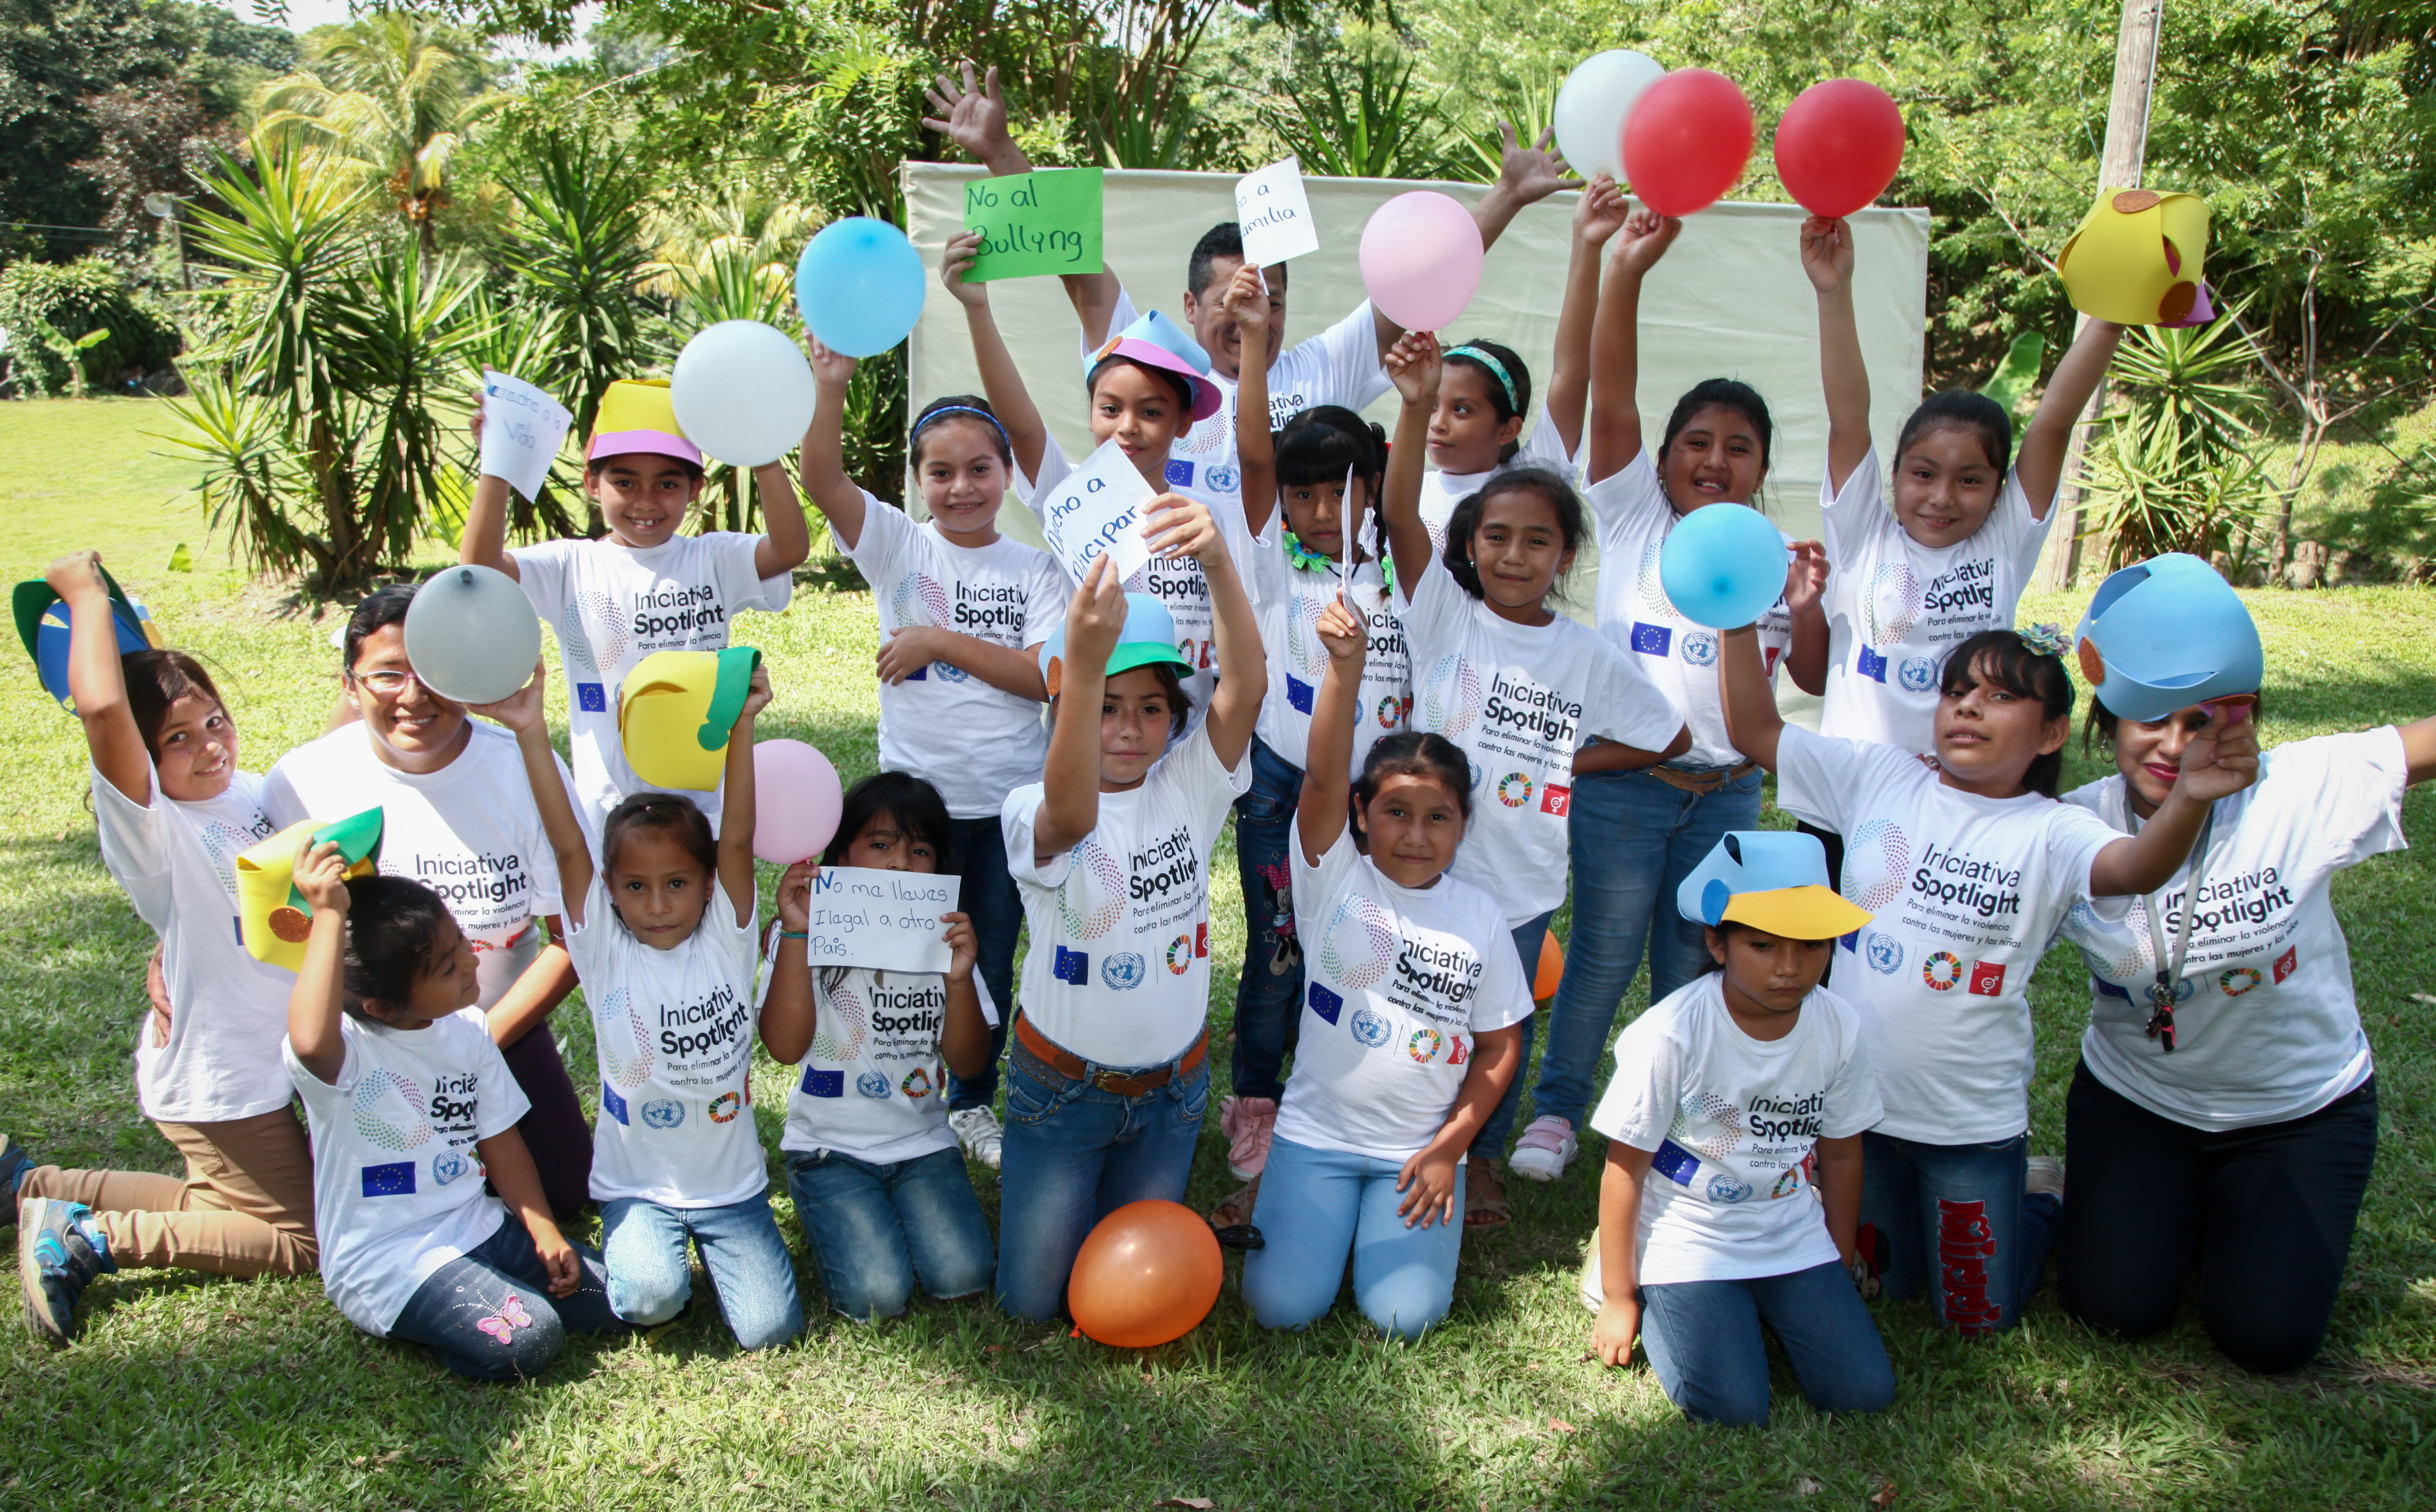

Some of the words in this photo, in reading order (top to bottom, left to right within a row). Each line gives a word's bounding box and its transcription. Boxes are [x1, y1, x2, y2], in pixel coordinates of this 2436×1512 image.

[968, 186, 998, 214] No
[1011, 179, 1038, 207] al
[1243, 207, 1297, 237] amilia
[973, 223, 1083, 262] Bullyng
[1233, 392, 1304, 412] Iativa
[1087, 477, 1106, 493] a
[635, 585, 714, 611] Iniciativa
[957, 580, 1028, 605] Iniciativ
[1925, 579, 1993, 613] Spotlig
[634, 604, 725, 638] Spotlight
[955, 603, 1026, 632] Spotlig
[1928, 617, 1946, 626] Para
[1948, 613, 1976, 624] eliminar
[638, 642, 656, 650] Para
[659, 638, 687, 648] eliminar
[689, 636, 697, 644] la
[976, 630, 1004, 639] eliminar
[1929, 632, 1951, 641] contra
[1953, 630, 1964, 638] las
[1375, 673, 1384, 682] las
[1491, 672, 1582, 719] Iniciativa
[1485, 697, 1578, 742] Spotligh
[1481, 725, 1499, 737] Para
[1501, 731, 1533, 745] eliminar
[1534, 740, 1541, 748] la
[1541, 742, 1573, 758] violencia
[1478, 741, 1502, 753] contra
[1504, 746, 1516, 756] las
[1517, 752, 1542, 764] mujeres
[1550, 759, 1560, 770] las
[416, 852, 519, 875] Iniciativa
[1922, 843, 2020, 887] Iniciativa
[816, 871, 842, 894] No
[1912, 868, 2020, 917] Spotlight
[2166, 867, 2278, 909] Inciativa
[449, 907, 479, 915] liminar
[482, 907, 490, 915] la
[493, 899, 526, 914] violencia
[1133, 908, 1149, 917] Para
[1151, 896, 1182, 912] eliminar
[1184, 891, 1191, 901] la
[1907, 898, 1924, 912] Para
[1926, 906, 1959, 921] eliminar
[1961, 914, 1969, 924] la
[1973, 918, 2009, 931] violencia
[468, 922, 501, 931] mujeres
[511, 916, 522, 924] las
[880, 915, 892, 926] a
[900, 908, 935, 930] otro
[1134, 920, 1157, 934] contra
[1160, 917, 1171, 927] las
[1902, 916, 1926, 929] contra
[1929, 922, 1940, 934] las
[1942, 928, 1975, 942] mujeres
[1976, 936, 1983, 945] y
[1985, 936, 1996, 945] las
[1999, 938, 2022, 948] niñas
[2198, 935, 2237, 947] eliminar
[2241, 931, 2250, 940] la
[1401, 930, 1482, 978] niciativa
[2209, 952, 2223, 960] las
[2227, 945, 2264, 958] mujeres
[2267, 941, 2272, 950] y
[2275, 934, 2285, 945] las
[1974, 961, 1980, 969] 5
[869, 986, 946, 1009] Iniciativ
[1392, 979, 1410, 993] Para
[1436, 1001, 1442, 1009] la
[1388, 996, 1411, 1009] contra
[1413, 1003, 1424, 1013] las
[1426, 1010, 1449, 1022] mujeres
[661, 1002, 748, 1059] Spotlight
[872, 1011, 942, 1036] Spotlig
[874, 1037, 891, 1046] Para
[667, 1062, 687, 1071] Para
[691, 1056, 721, 1070] eliminar
[723, 1050, 729, 1061] la
[875, 1051, 897, 1060] contra
[671, 1077, 698, 1085] contra
[701, 1076, 713, 1084] las
[716, 1064, 738, 1083] mujeres
[738, 1060, 741, 1069] y
[1749, 1091, 1824, 1115] Iniciati
[1750, 1115, 1822, 1143] Spotlig
[1752, 1144, 1772, 1154] Para
[1800, 1142, 1808, 1151] la
[1750, 1160, 1776, 1169] contra
[1779, 1159, 1790, 1169] las
